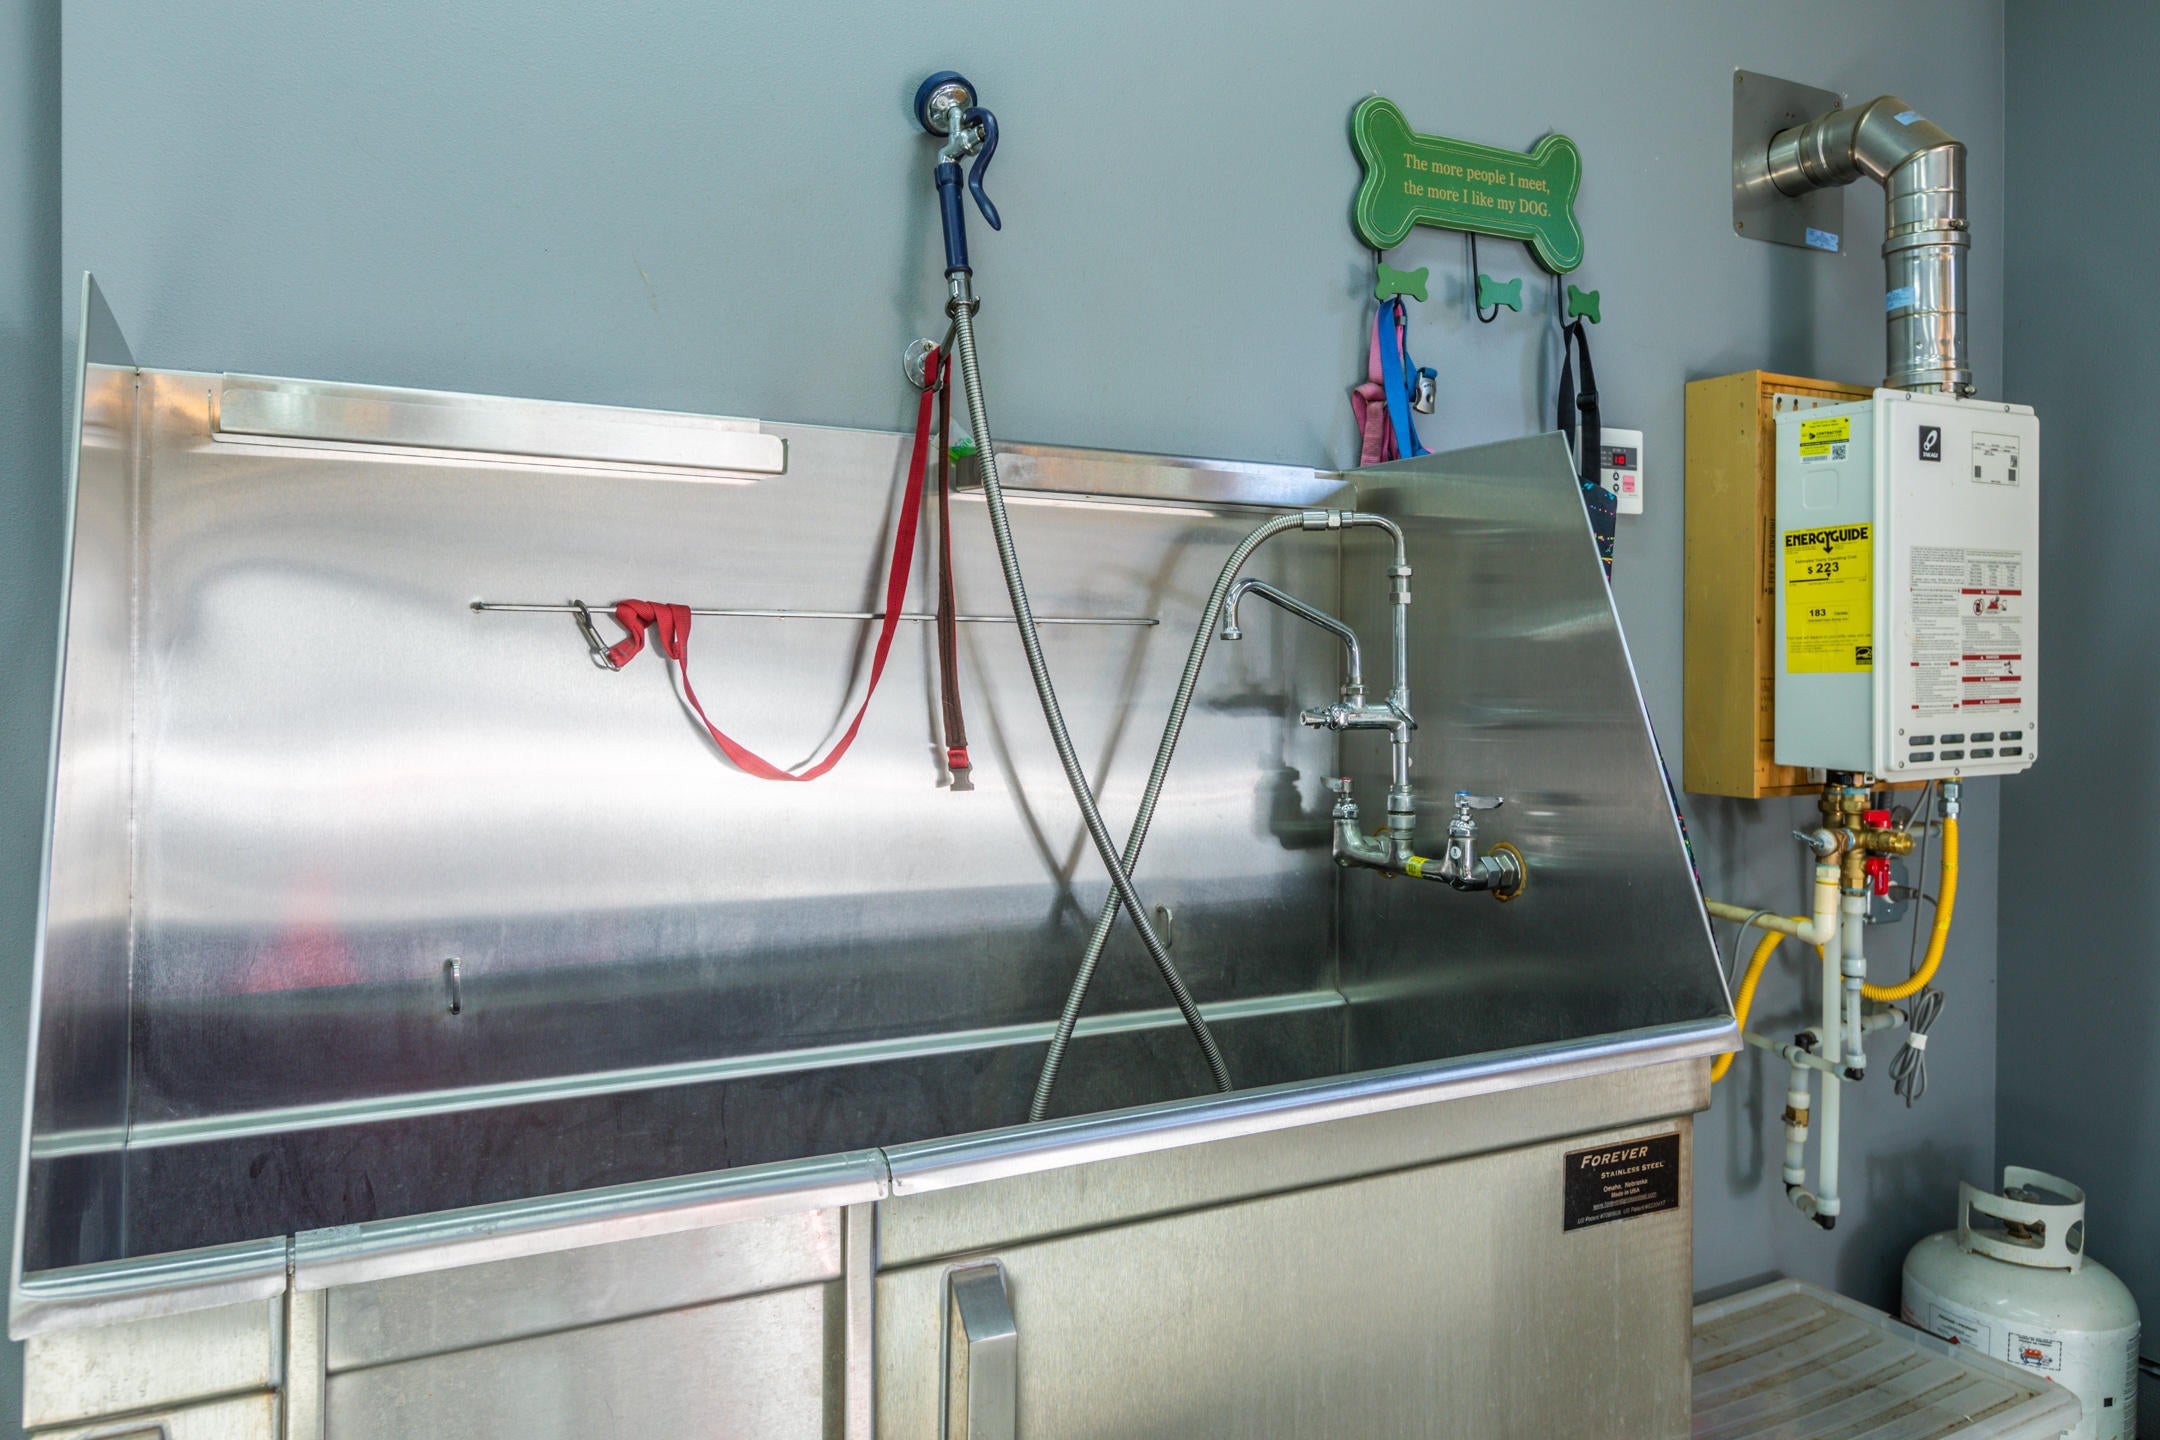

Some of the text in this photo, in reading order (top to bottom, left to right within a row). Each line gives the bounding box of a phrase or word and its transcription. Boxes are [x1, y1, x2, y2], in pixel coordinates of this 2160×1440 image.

[1403, 153, 1550, 196] The more people I meet,
[1403, 180, 1551, 217] the more I like my DOG.
[1807, 561, 1839, 575] $ 223
[1809, 608, 1826, 617] 183
[1580, 1145, 1649, 1169] FOREVER
[1601, 1161, 1665, 1179] STAINLESS STEEL
